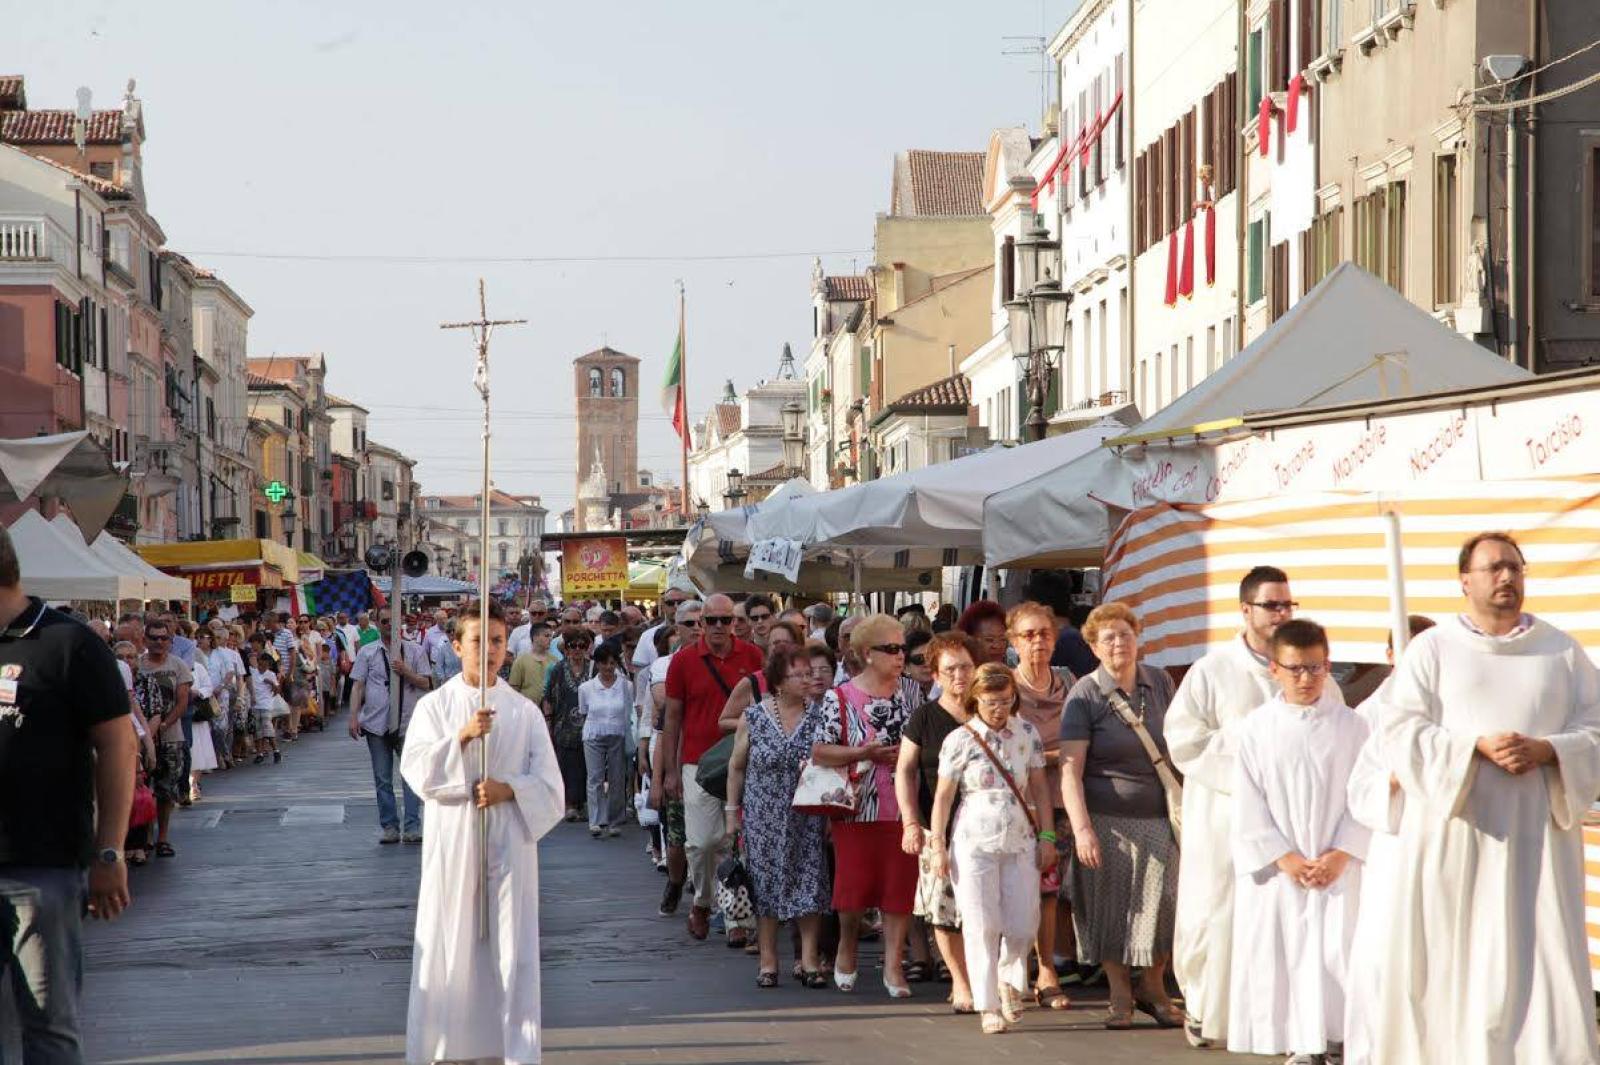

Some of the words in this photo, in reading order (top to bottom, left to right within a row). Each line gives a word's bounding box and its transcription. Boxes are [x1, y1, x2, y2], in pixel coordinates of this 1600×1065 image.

[1274, 439, 1315, 489] Torrone
[1332, 424, 1386, 487] Mandorle
[1409, 415, 1464, 480] Nocciole
[1526, 413, 1582, 470] Tarcisio
[567, 571, 626, 582] PORCHETTA
